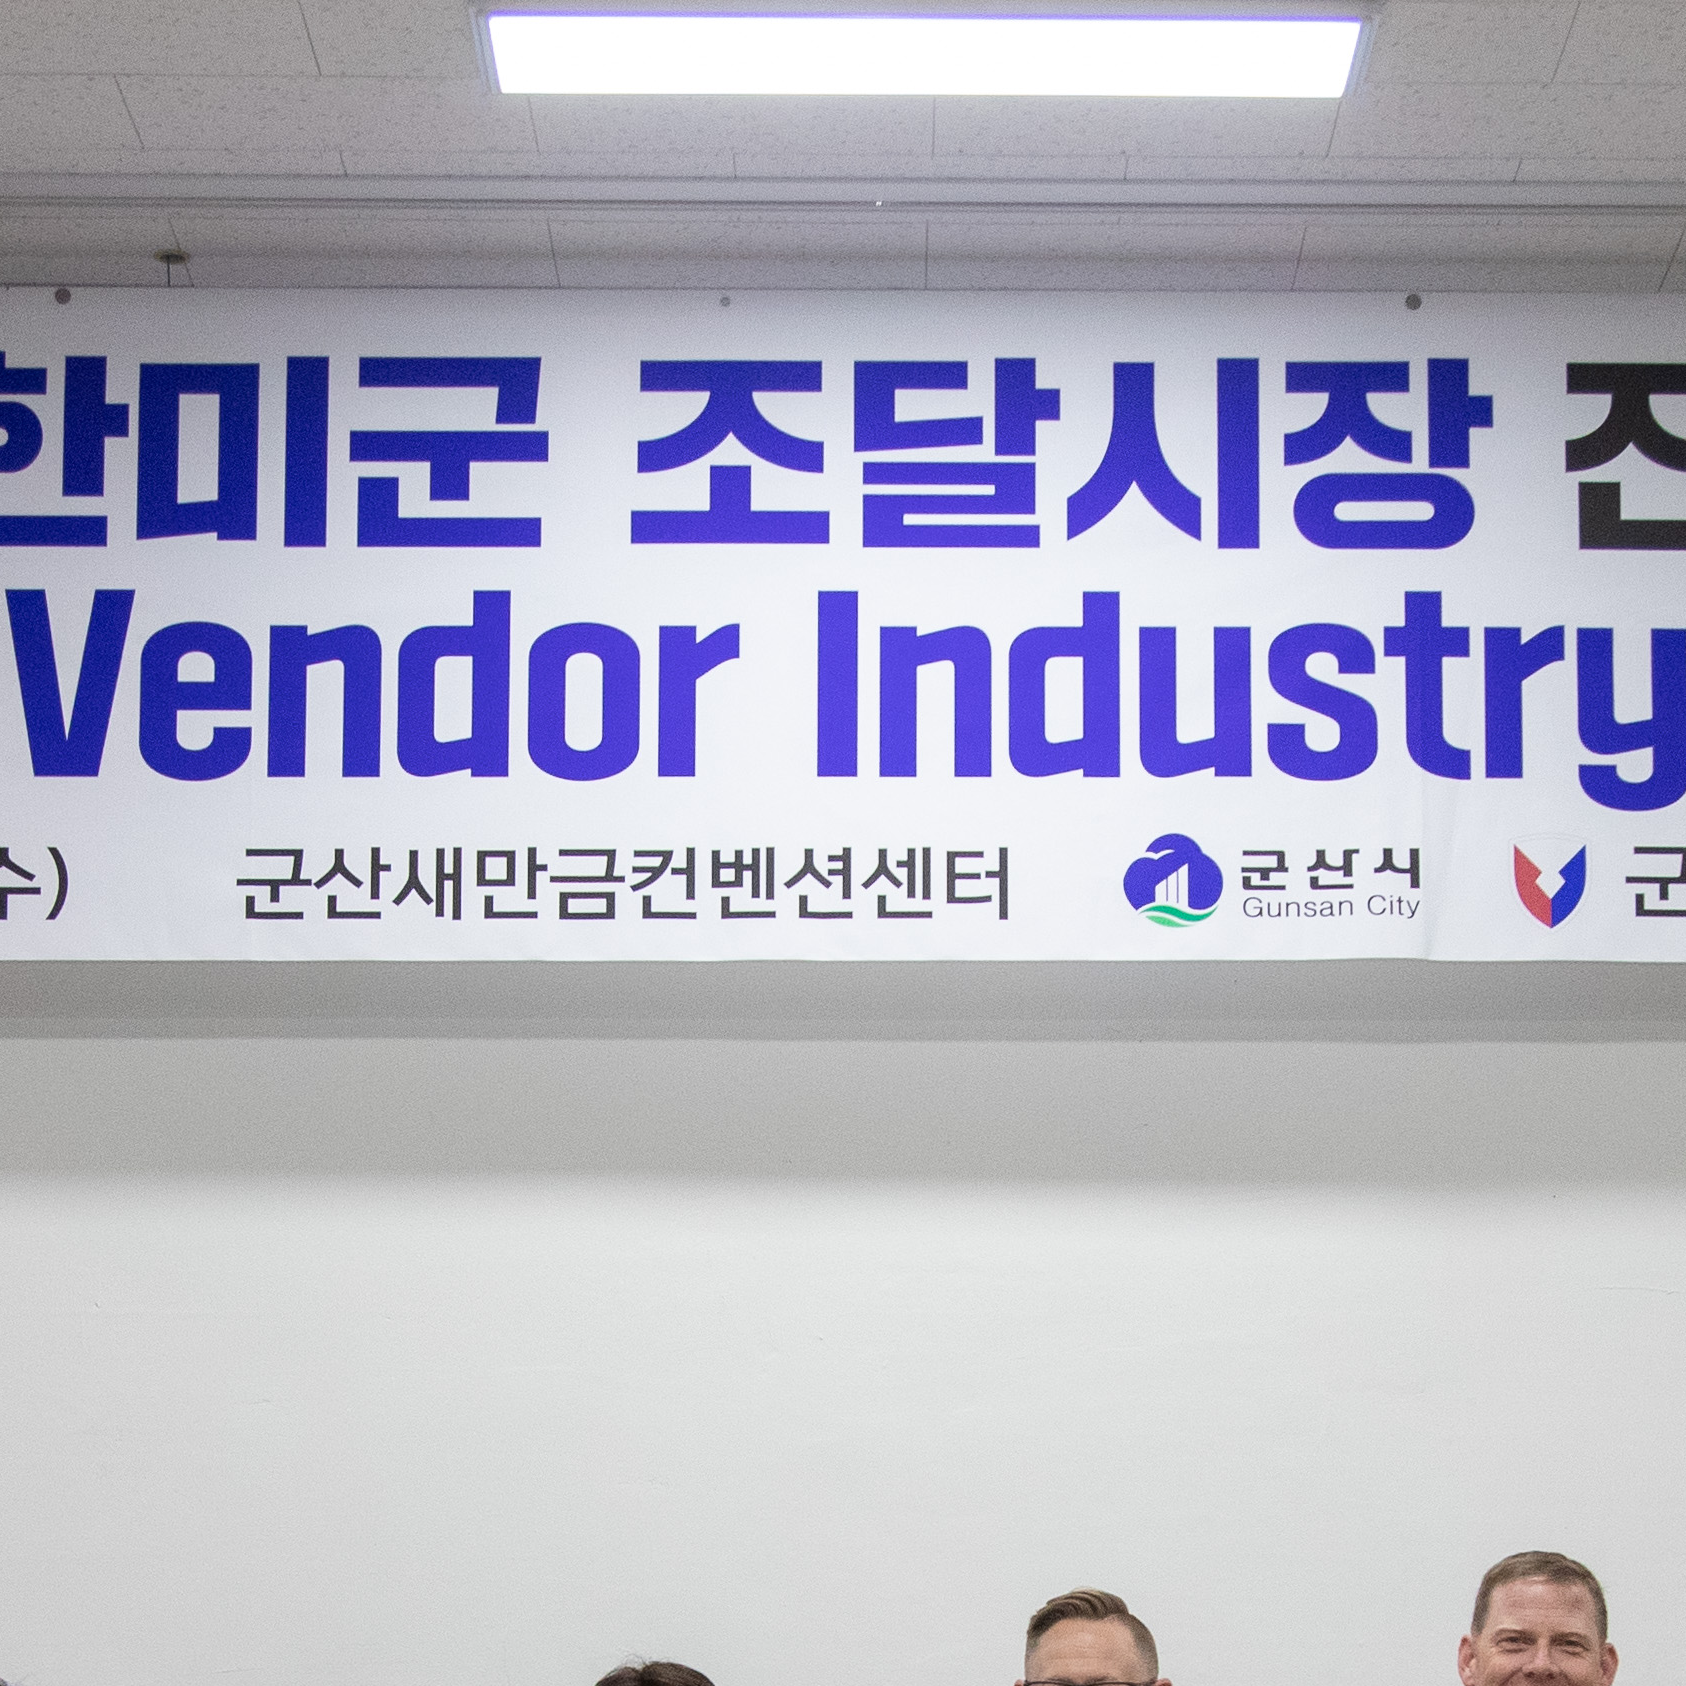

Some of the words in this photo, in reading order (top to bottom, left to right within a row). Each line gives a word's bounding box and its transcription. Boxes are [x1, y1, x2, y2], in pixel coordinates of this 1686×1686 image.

[631, 356, 1494, 550] 조달시장
[4, 588, 740, 782] Vendor
[236, 846, 1009, 921] 군산새만금컨벤션센터
[1241, 847, 1421, 891] 군산시
[1242, 896, 1354, 918] Gunsan
[1367, 894, 1421, 919] City
